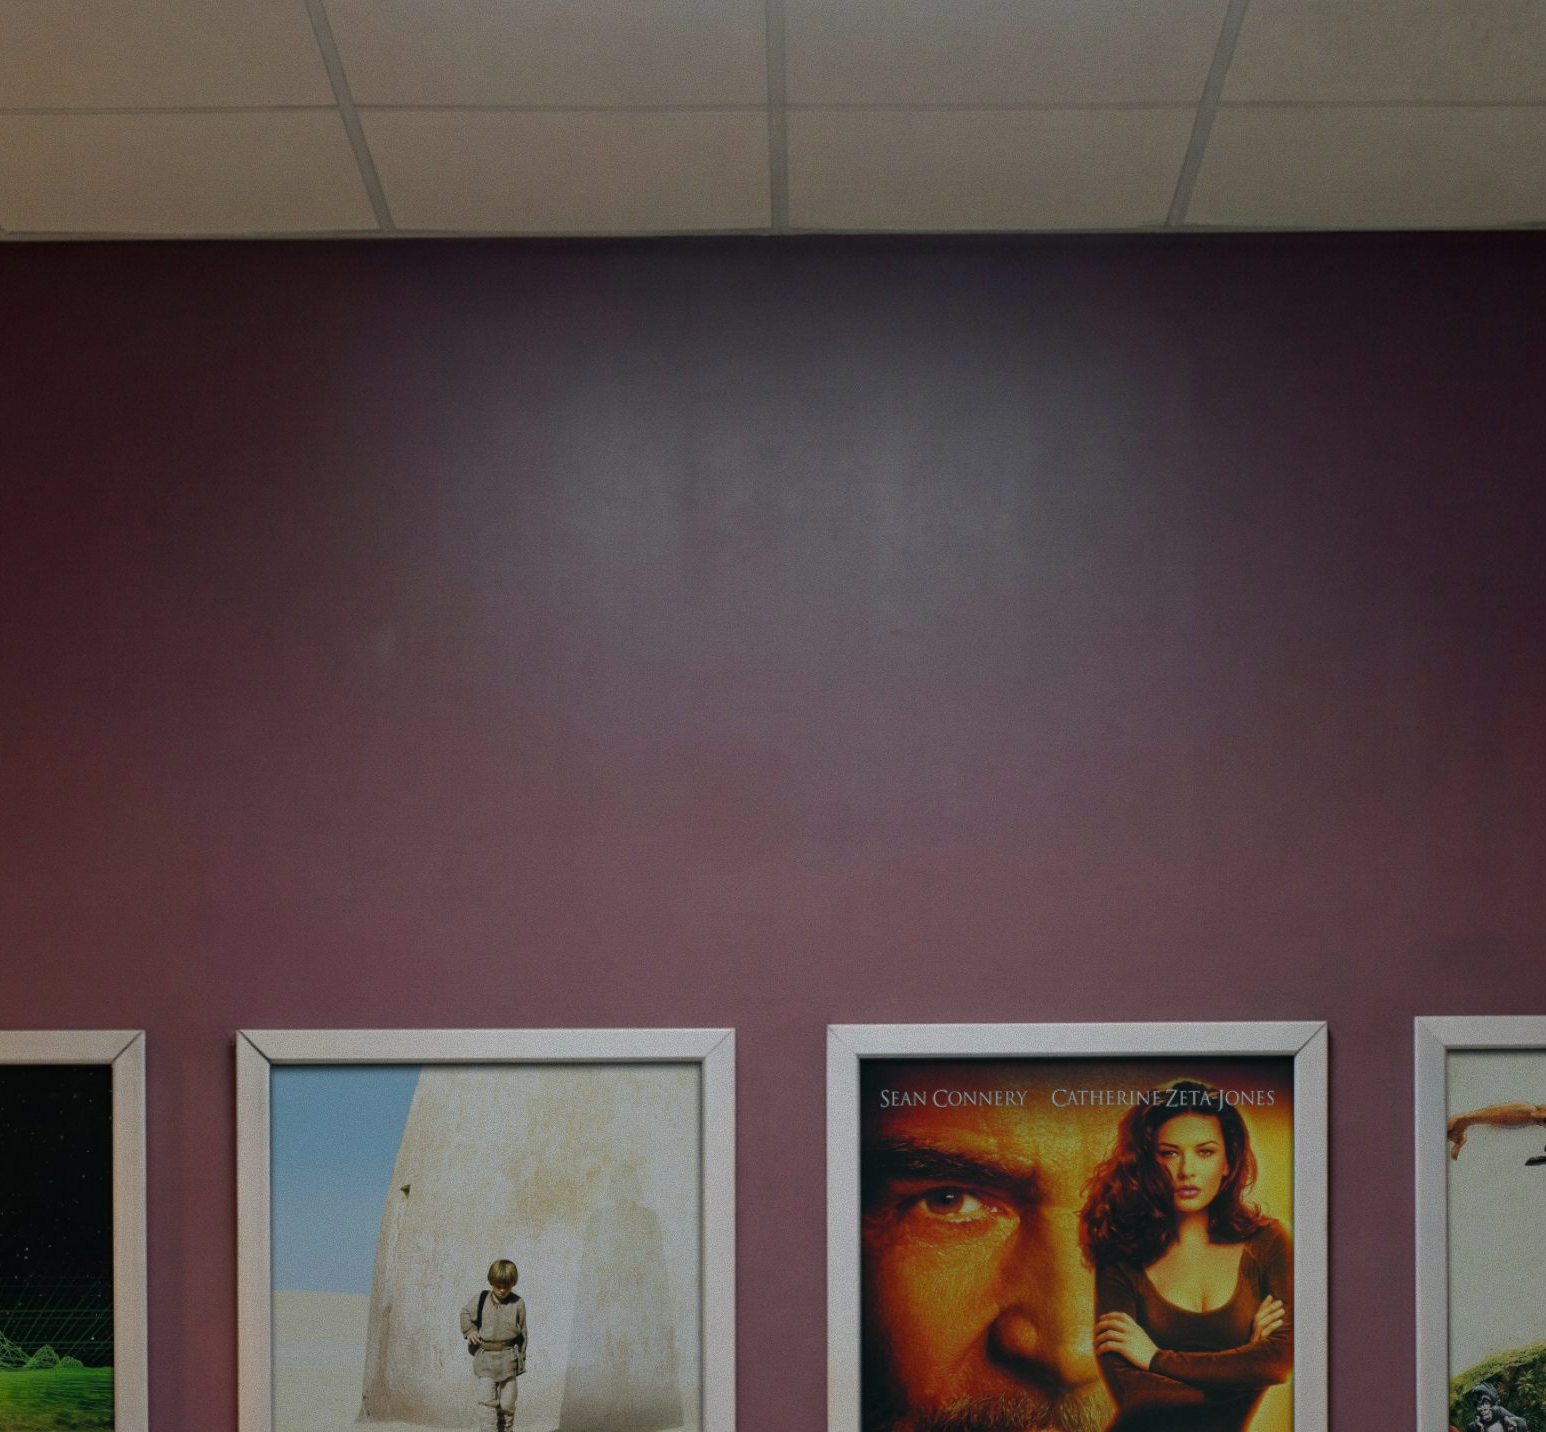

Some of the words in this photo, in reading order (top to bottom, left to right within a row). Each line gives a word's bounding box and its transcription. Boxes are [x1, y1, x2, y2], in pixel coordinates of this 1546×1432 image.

[880, 1089, 927, 1108] SEAN
[932, 1089, 1028, 1108] CONNERY
[1051, 1089, 1161, 1108] CATHERINE
[1165, 1089, 1275, 1111] ZETA-JONES
